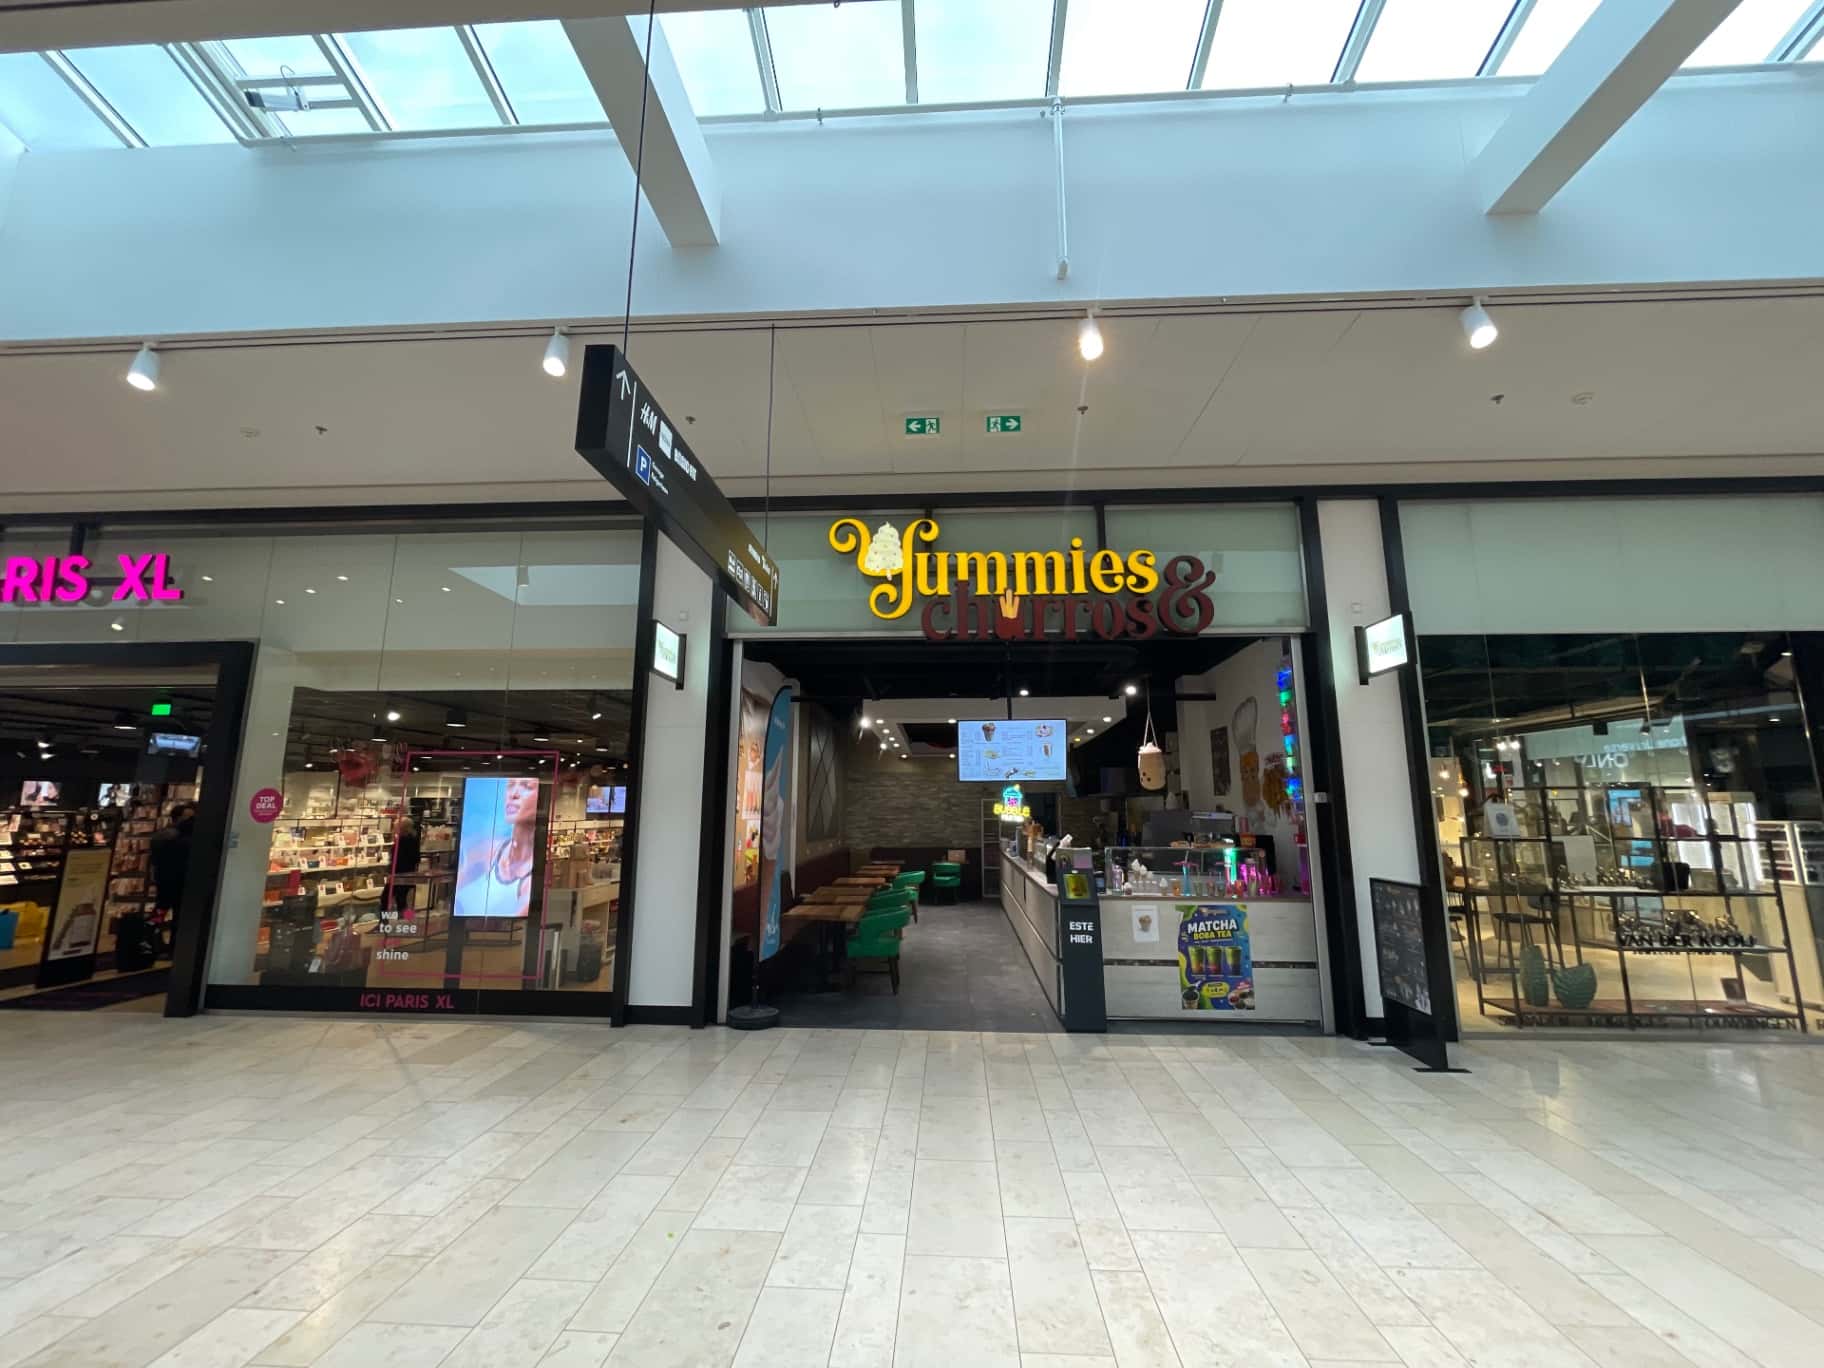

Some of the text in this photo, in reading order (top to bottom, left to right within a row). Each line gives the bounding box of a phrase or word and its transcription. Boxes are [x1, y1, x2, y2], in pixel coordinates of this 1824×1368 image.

[640, 456, 647, 472] P
[829, 518, 1159, 619] Yummies
[0, 552, 184, 603] RIS XL
[921, 580, 1159, 640] churros
[379, 924, 417, 933] to see
[1187, 919, 1237, 934] MATCHA
[1070, 934, 1093, 944] HIER
[1193, 930, 1232, 940] BOBA TEA
[1618, 934, 1653, 947] VAN
[1660, 935, 1692, 947] DER
[376, 949, 409, 961] shine
[360, 993, 455, 1009] ICI PARIS XL
